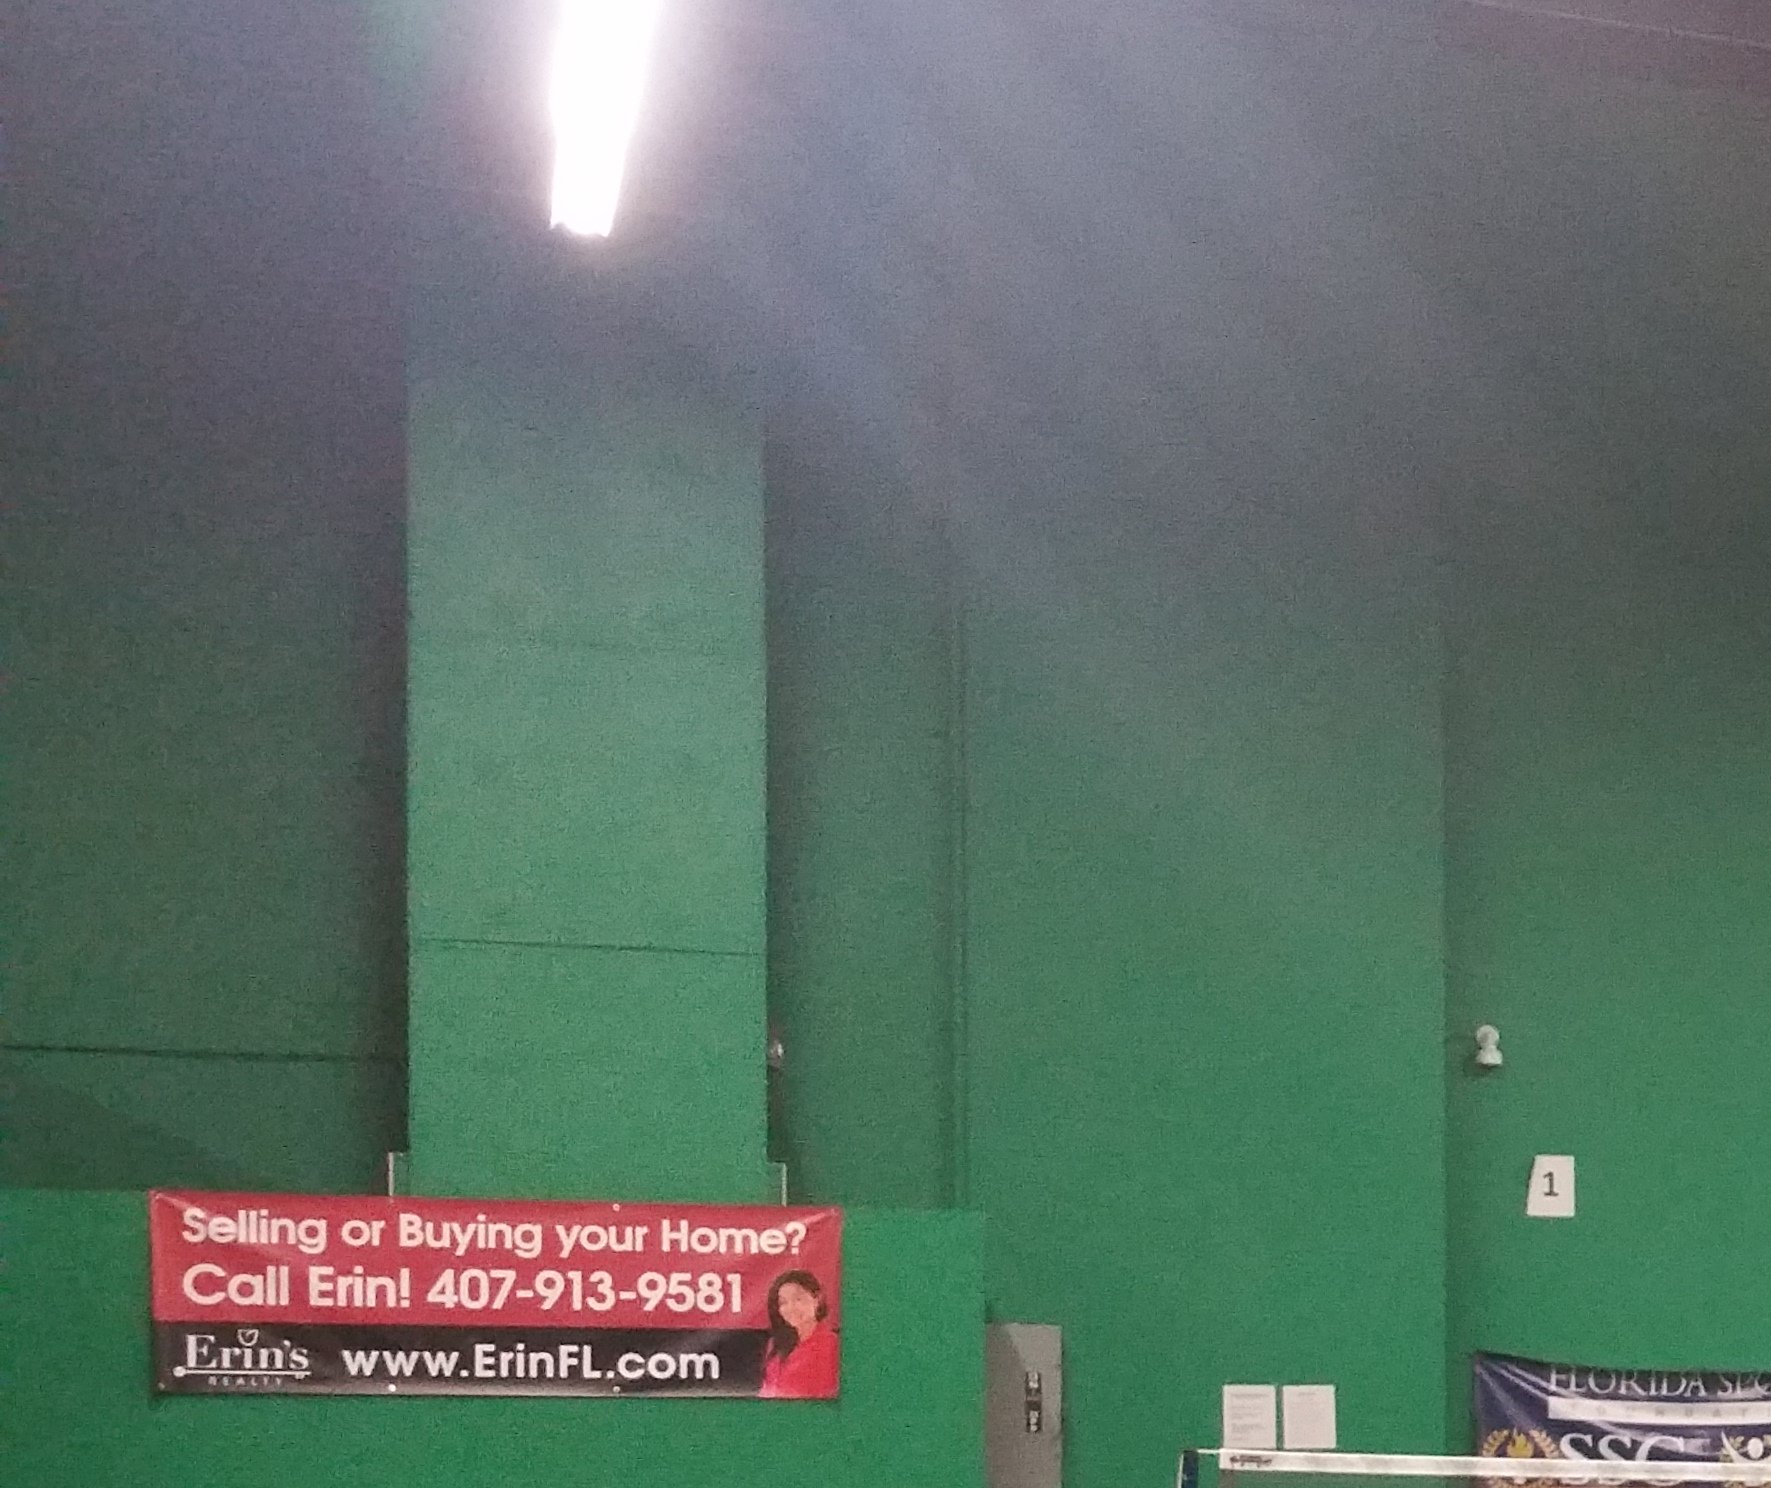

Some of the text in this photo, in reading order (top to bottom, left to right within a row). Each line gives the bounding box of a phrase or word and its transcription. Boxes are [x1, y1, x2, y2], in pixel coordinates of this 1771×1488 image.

[1543, 1171, 1559, 1196] 1
[182, 1209, 806, 1260] Selling or Buying your Home?
[182, 1263, 742, 1314] Call Erin! 407-913-9581
[185, 1334, 310, 1370] Erin's
[342, 1341, 720, 1381] www.ErinFL.com
[1550, 1366, 1707, 1397] FLORIDA
